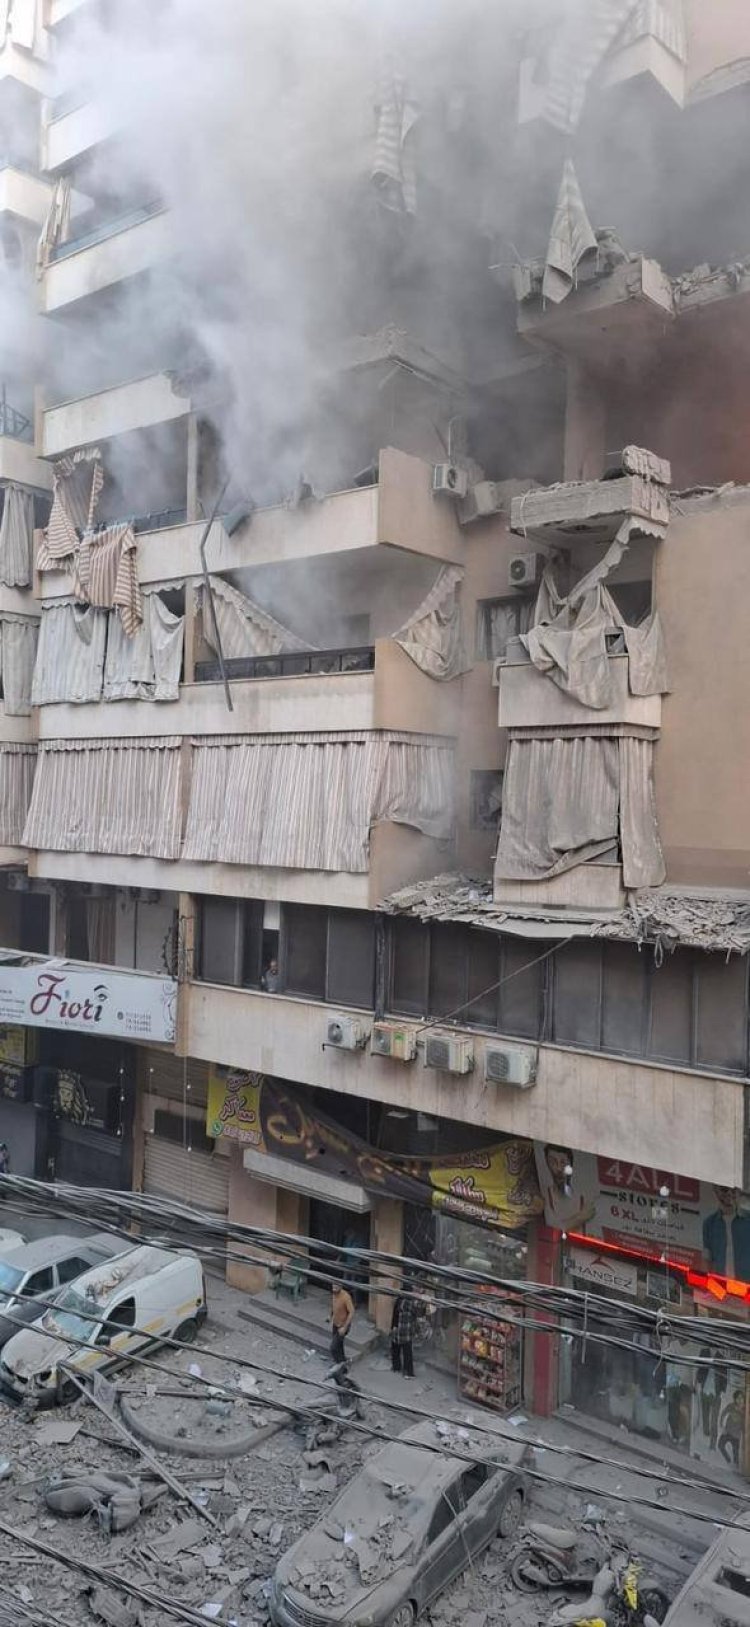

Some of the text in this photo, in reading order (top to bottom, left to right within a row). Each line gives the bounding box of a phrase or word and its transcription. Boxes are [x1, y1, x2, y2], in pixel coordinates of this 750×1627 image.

[30, 974, 103, 1022] Fiori
[605, 1160, 694, 1197] 4ALL
[619, 1192, 680, 1214] STORES
[622, 1208, 639, 1223] XL
